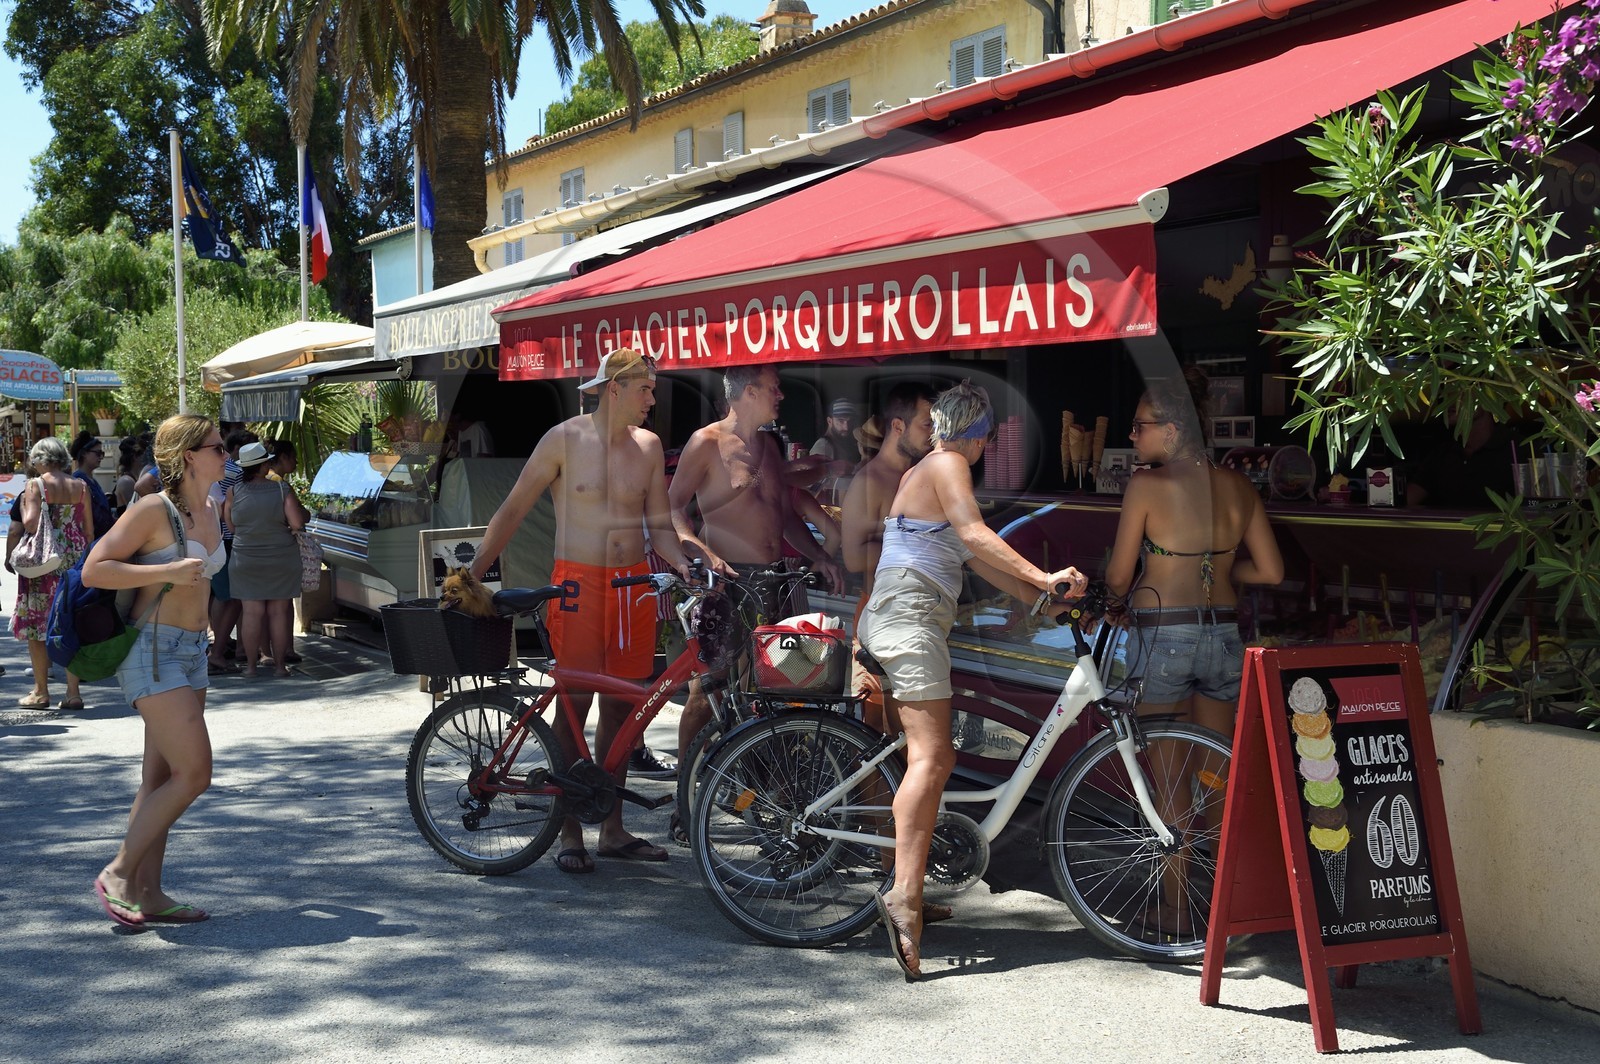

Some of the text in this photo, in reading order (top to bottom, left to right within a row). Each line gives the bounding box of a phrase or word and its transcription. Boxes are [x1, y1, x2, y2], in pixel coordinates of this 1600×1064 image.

[562, 253, 1094, 369] LE GLACIER PORQUEROLLAIS
[0, 368, 60, 384] GLACES
[635, 678, 673, 721] arcade
[1341, 701, 1401, 714] MAISON PESCE
[1023, 723, 1055, 769] Gitane
[1347, 733, 1409, 766] GLACES
[1353, 764, 1413, 785] artisanales
[1366, 793, 1420, 869] 60
[1369, 874, 1432, 899] PARFUMS
[1330, 921, 1368, 935] GLACIER
[1369, 914, 1438, 931] PORQUEROLLAIS
